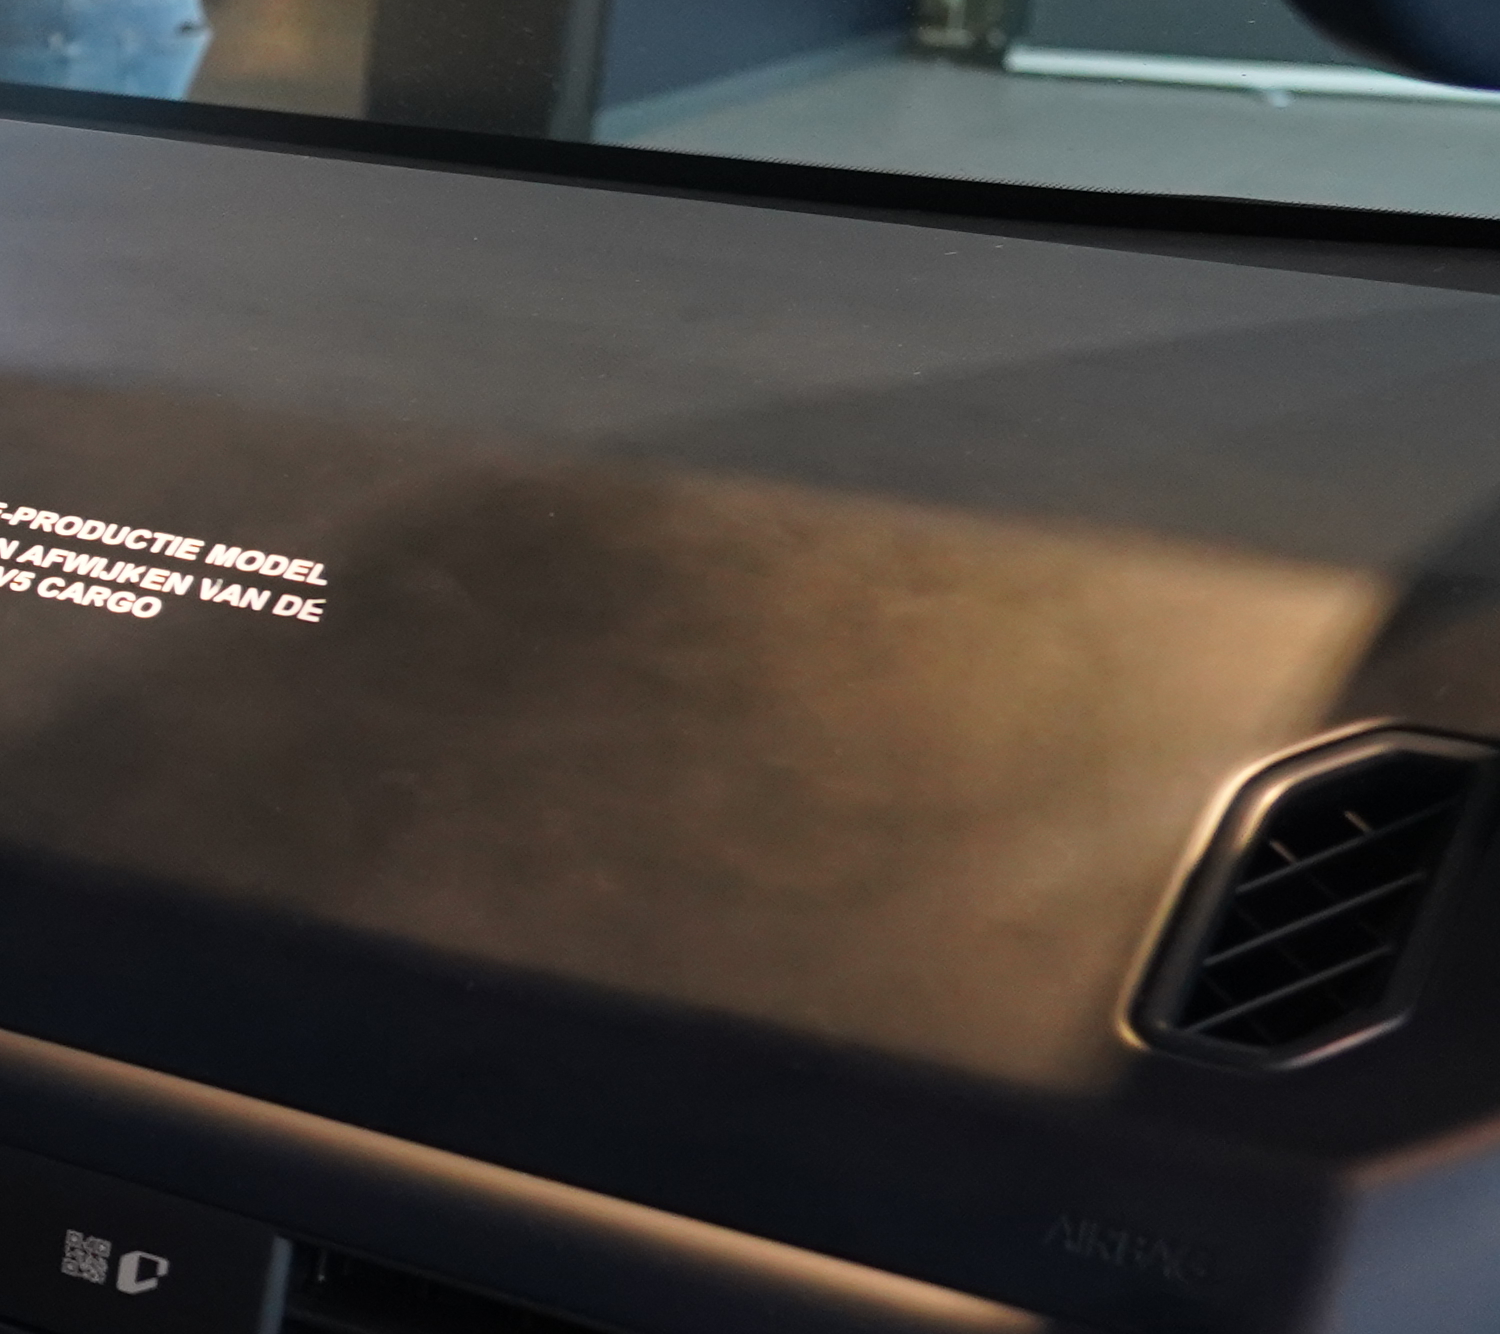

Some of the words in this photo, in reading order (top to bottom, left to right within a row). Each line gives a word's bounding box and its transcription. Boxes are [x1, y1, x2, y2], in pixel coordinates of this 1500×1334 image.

[18, 543, 193, 597] AFWIJKEN
[199, 578, 272, 614] VAN
[272, 595, 327, 623] DE
[205, 543, 329, 585] MODEL
[36, 573, 164, 619] CARGO
